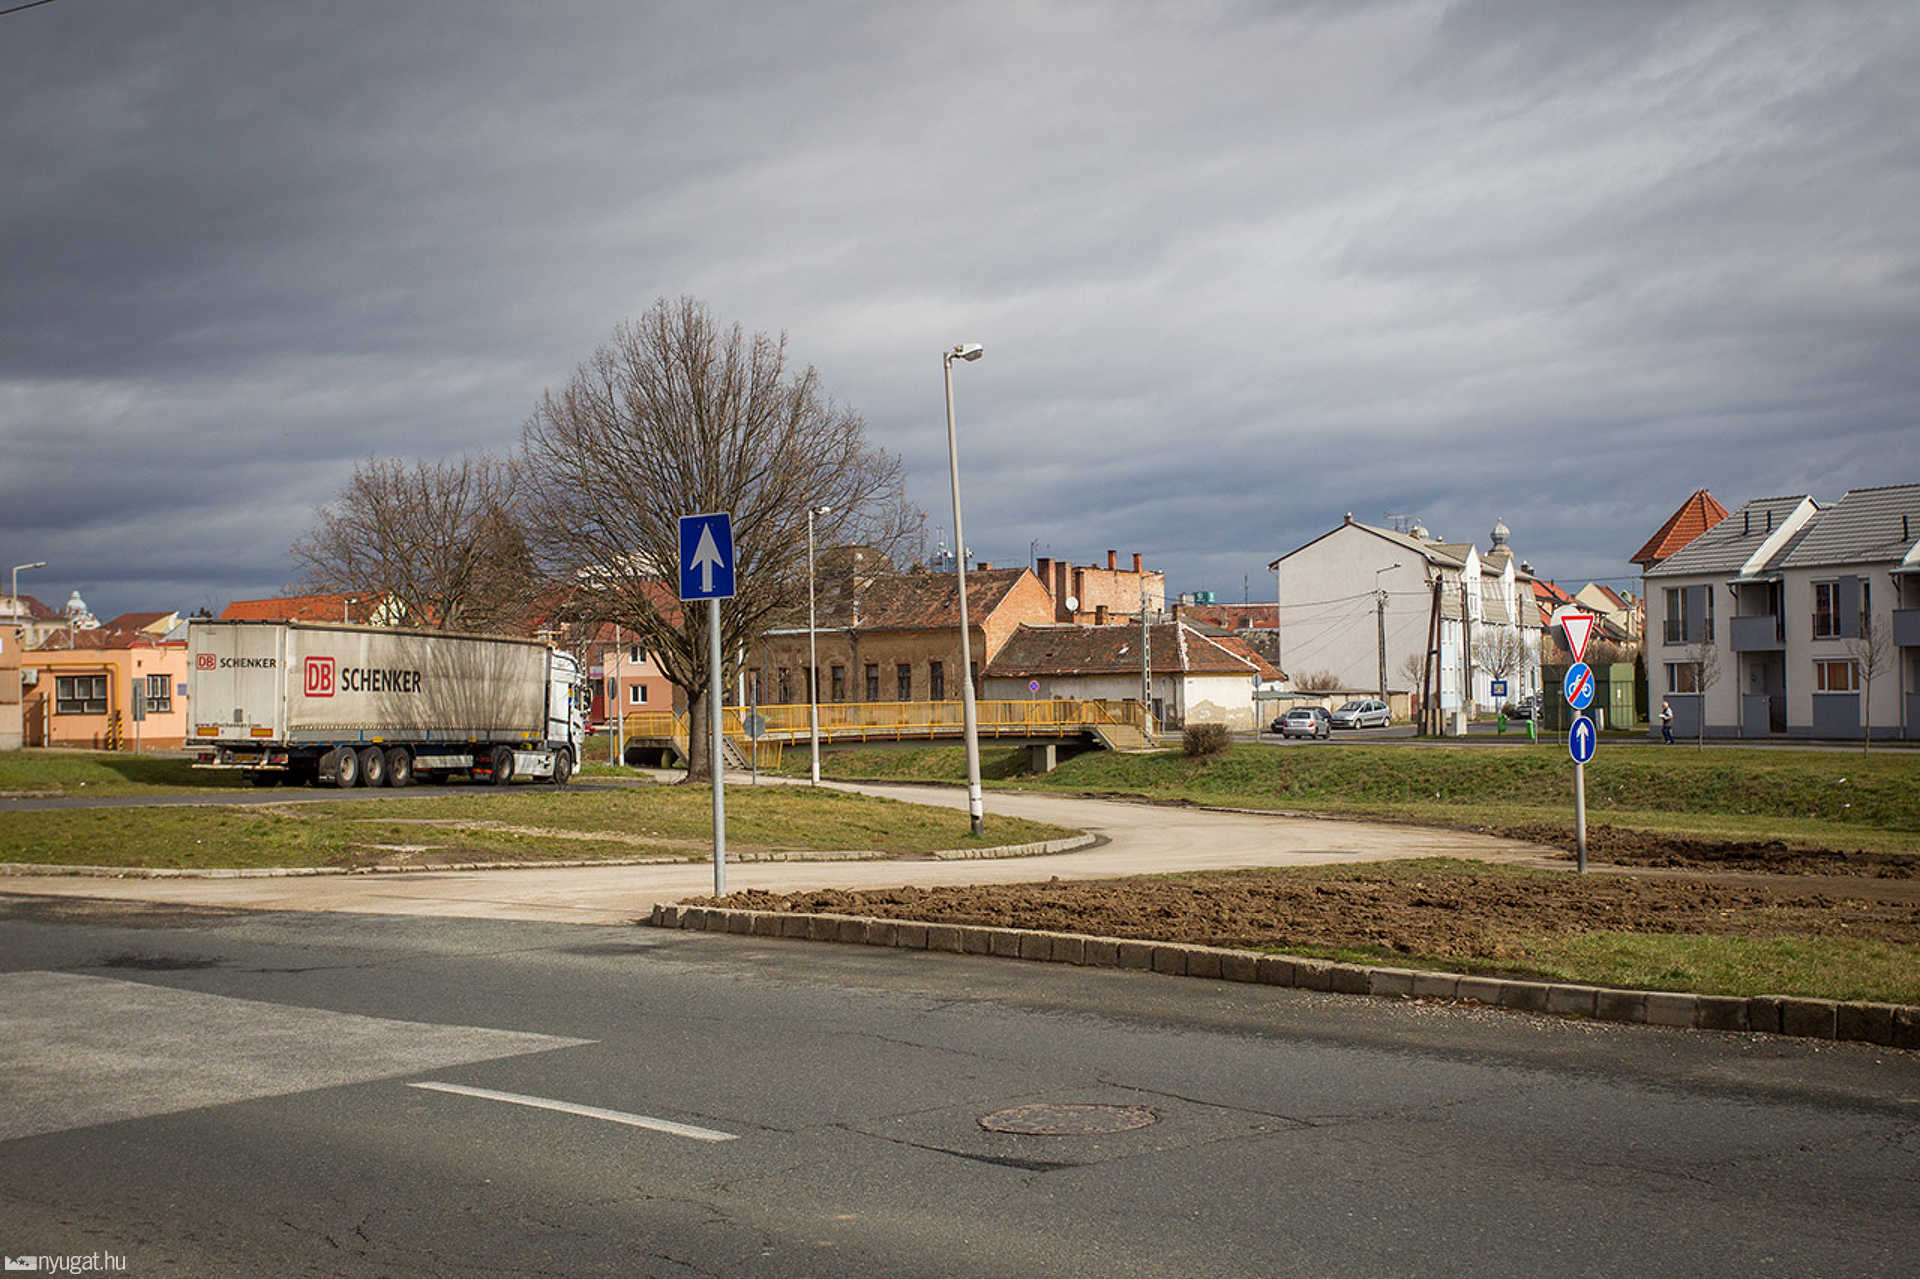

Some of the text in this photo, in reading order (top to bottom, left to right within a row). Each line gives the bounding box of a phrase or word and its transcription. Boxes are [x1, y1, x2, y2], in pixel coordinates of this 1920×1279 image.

[198, 655, 277, 668] DB SCHENKER
[308, 663, 421, 693] DB SCHENKER
